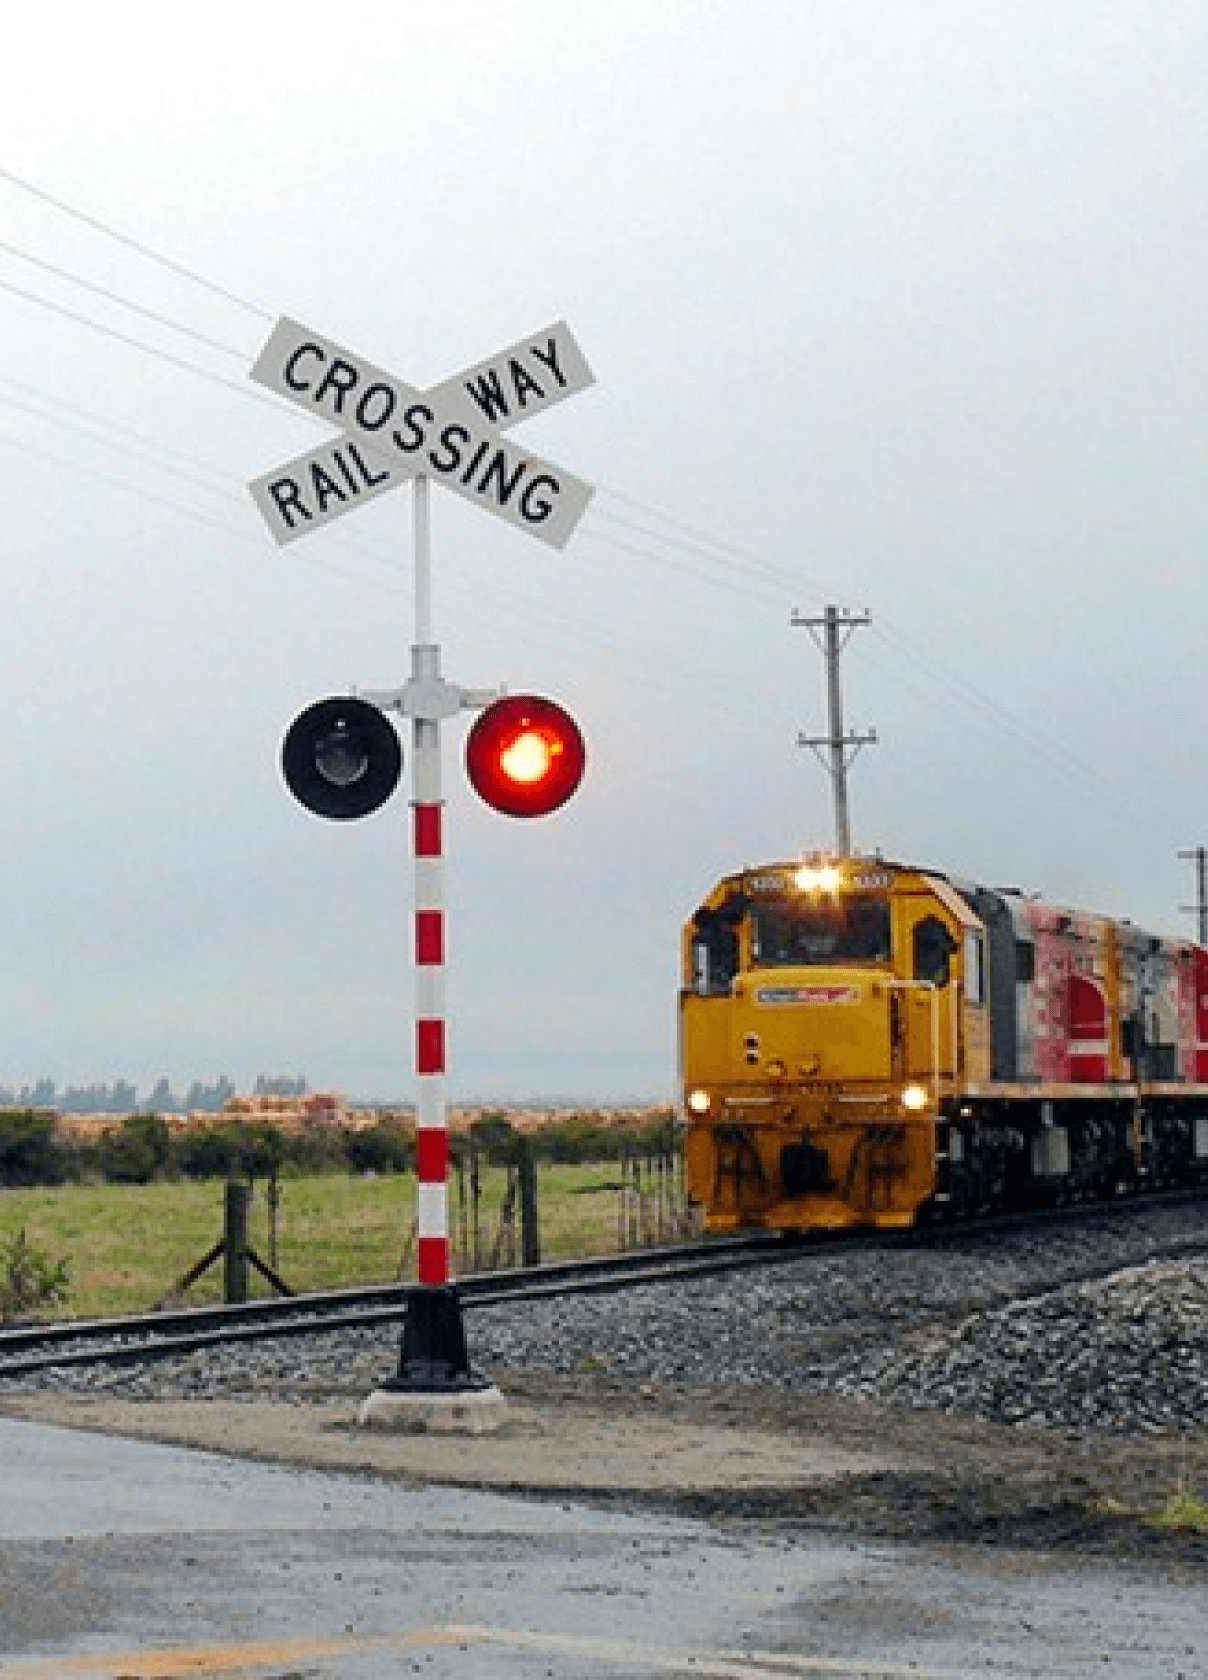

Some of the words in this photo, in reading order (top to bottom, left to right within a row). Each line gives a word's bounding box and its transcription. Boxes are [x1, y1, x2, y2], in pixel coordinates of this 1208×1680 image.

[267, 443, 390, 527] RAIL
[464, 339, 567, 421] WAY
[284, 343, 560, 522] CROSSING
